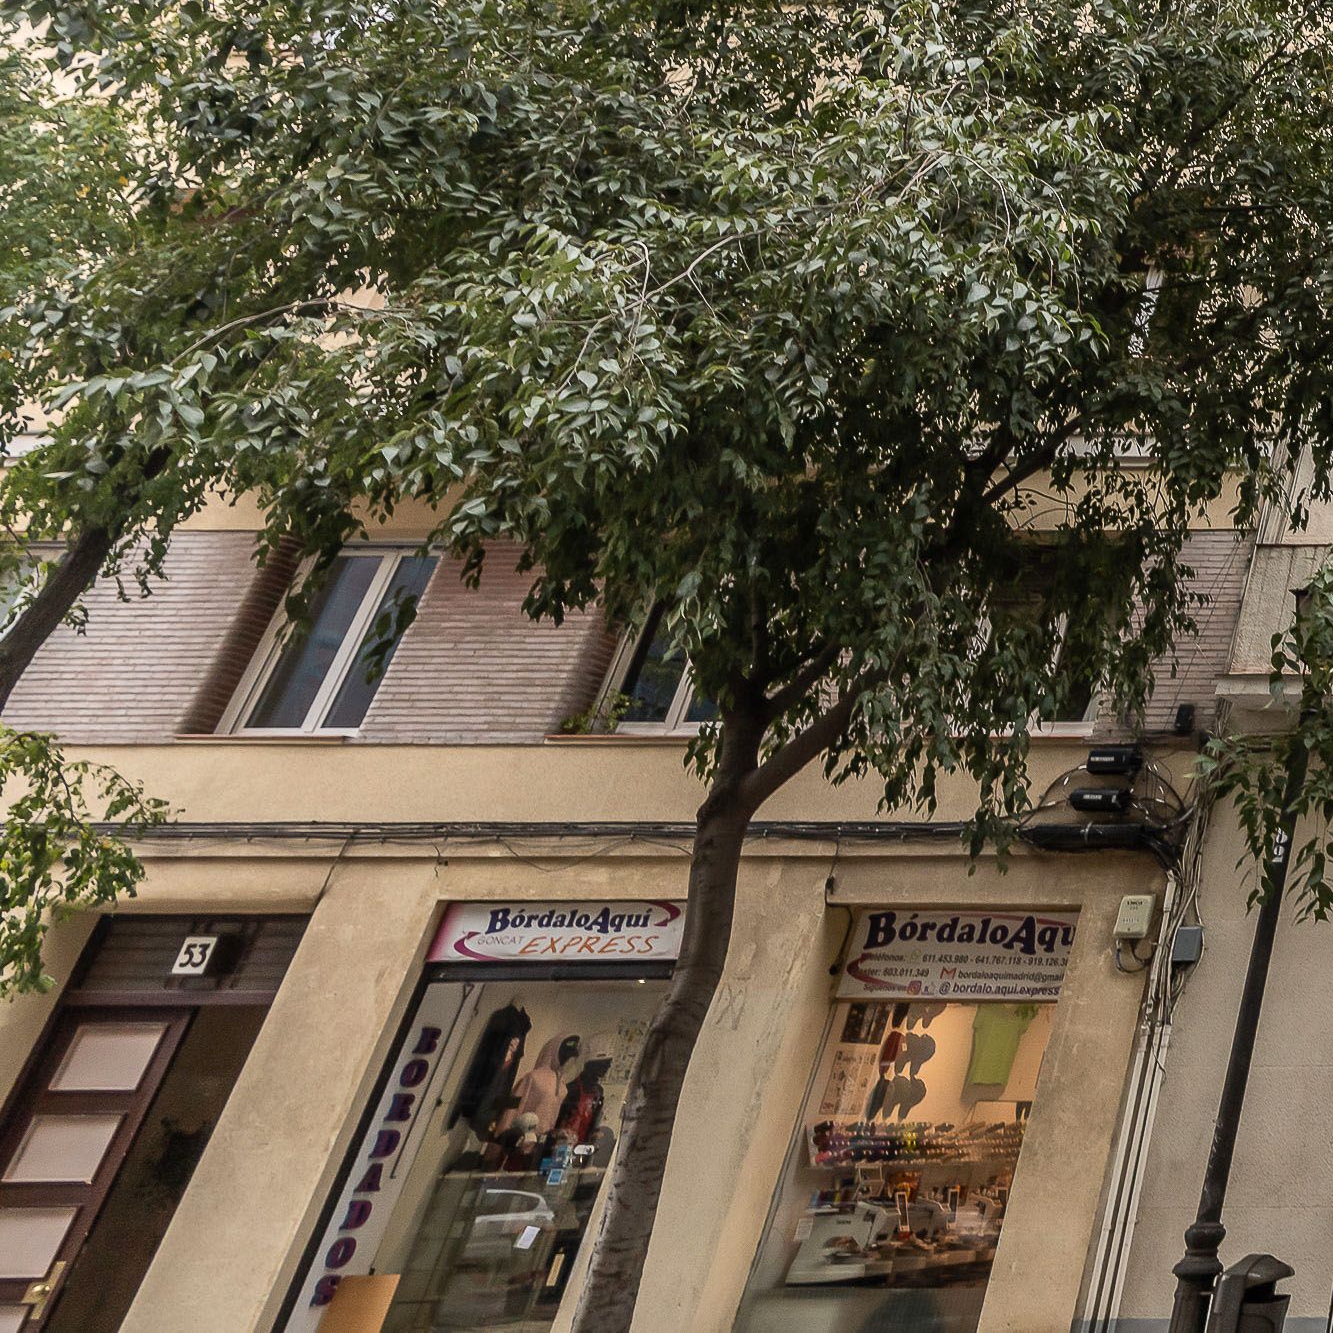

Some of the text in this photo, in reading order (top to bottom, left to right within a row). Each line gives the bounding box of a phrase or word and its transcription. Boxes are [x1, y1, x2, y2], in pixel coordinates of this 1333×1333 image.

[485, 906, 653, 935] BórdaloAquí
[178, 943, 211, 968] 53
[518, 935, 660, 955] EXPRESS
[309, 1027, 442, 1308] BORDADOS
